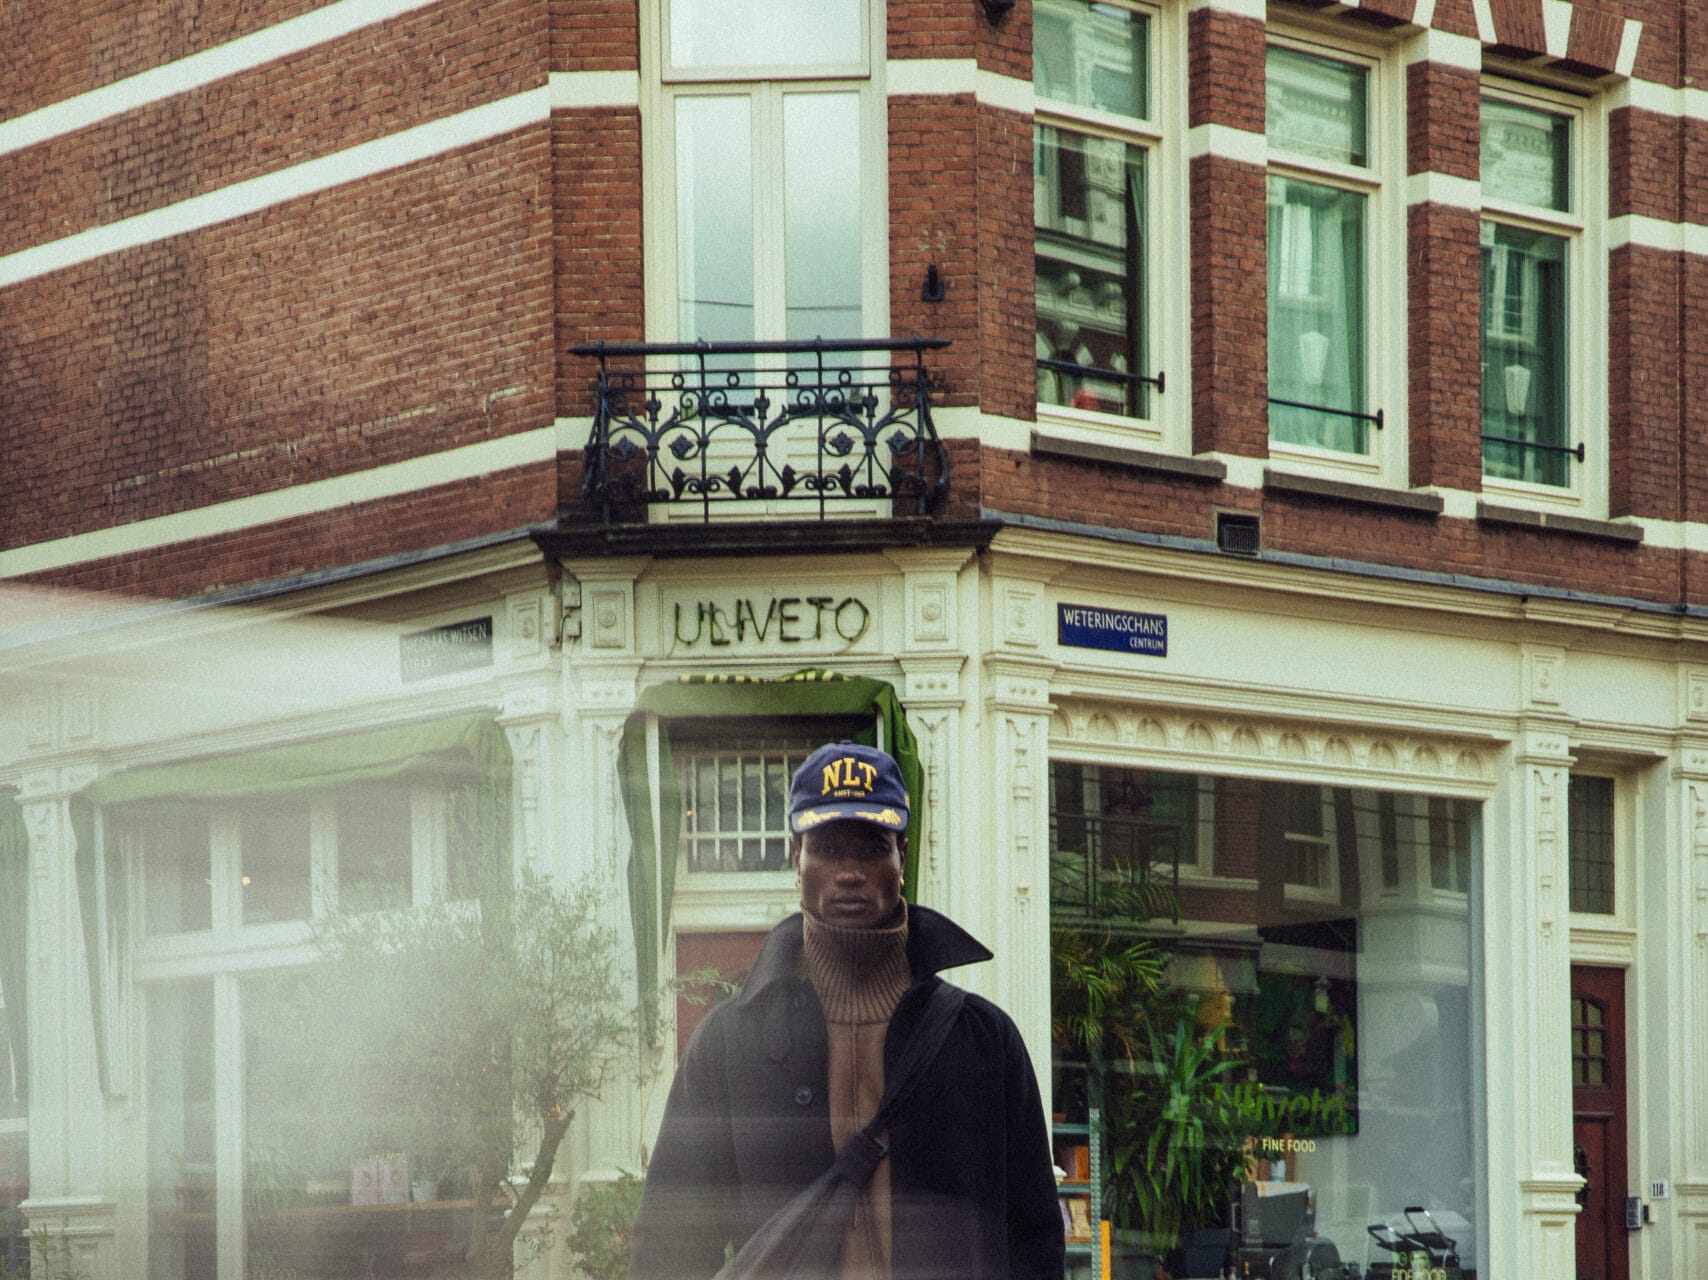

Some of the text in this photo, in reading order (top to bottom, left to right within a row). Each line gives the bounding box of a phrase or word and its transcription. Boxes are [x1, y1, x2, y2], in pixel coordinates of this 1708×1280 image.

[674, 597, 869, 645] ULIVETO
[1063, 607, 1164, 636] WETERINGSCHANS
[402, 623, 487, 657] NICOLAAS WITSEN
[1129, 637, 1164, 650] CENTRUM
[821, 757, 878, 797] NLT
[1262, 1138, 1316, 1153] FINE FOOD
[1652, 1183, 1664, 1197] 118
